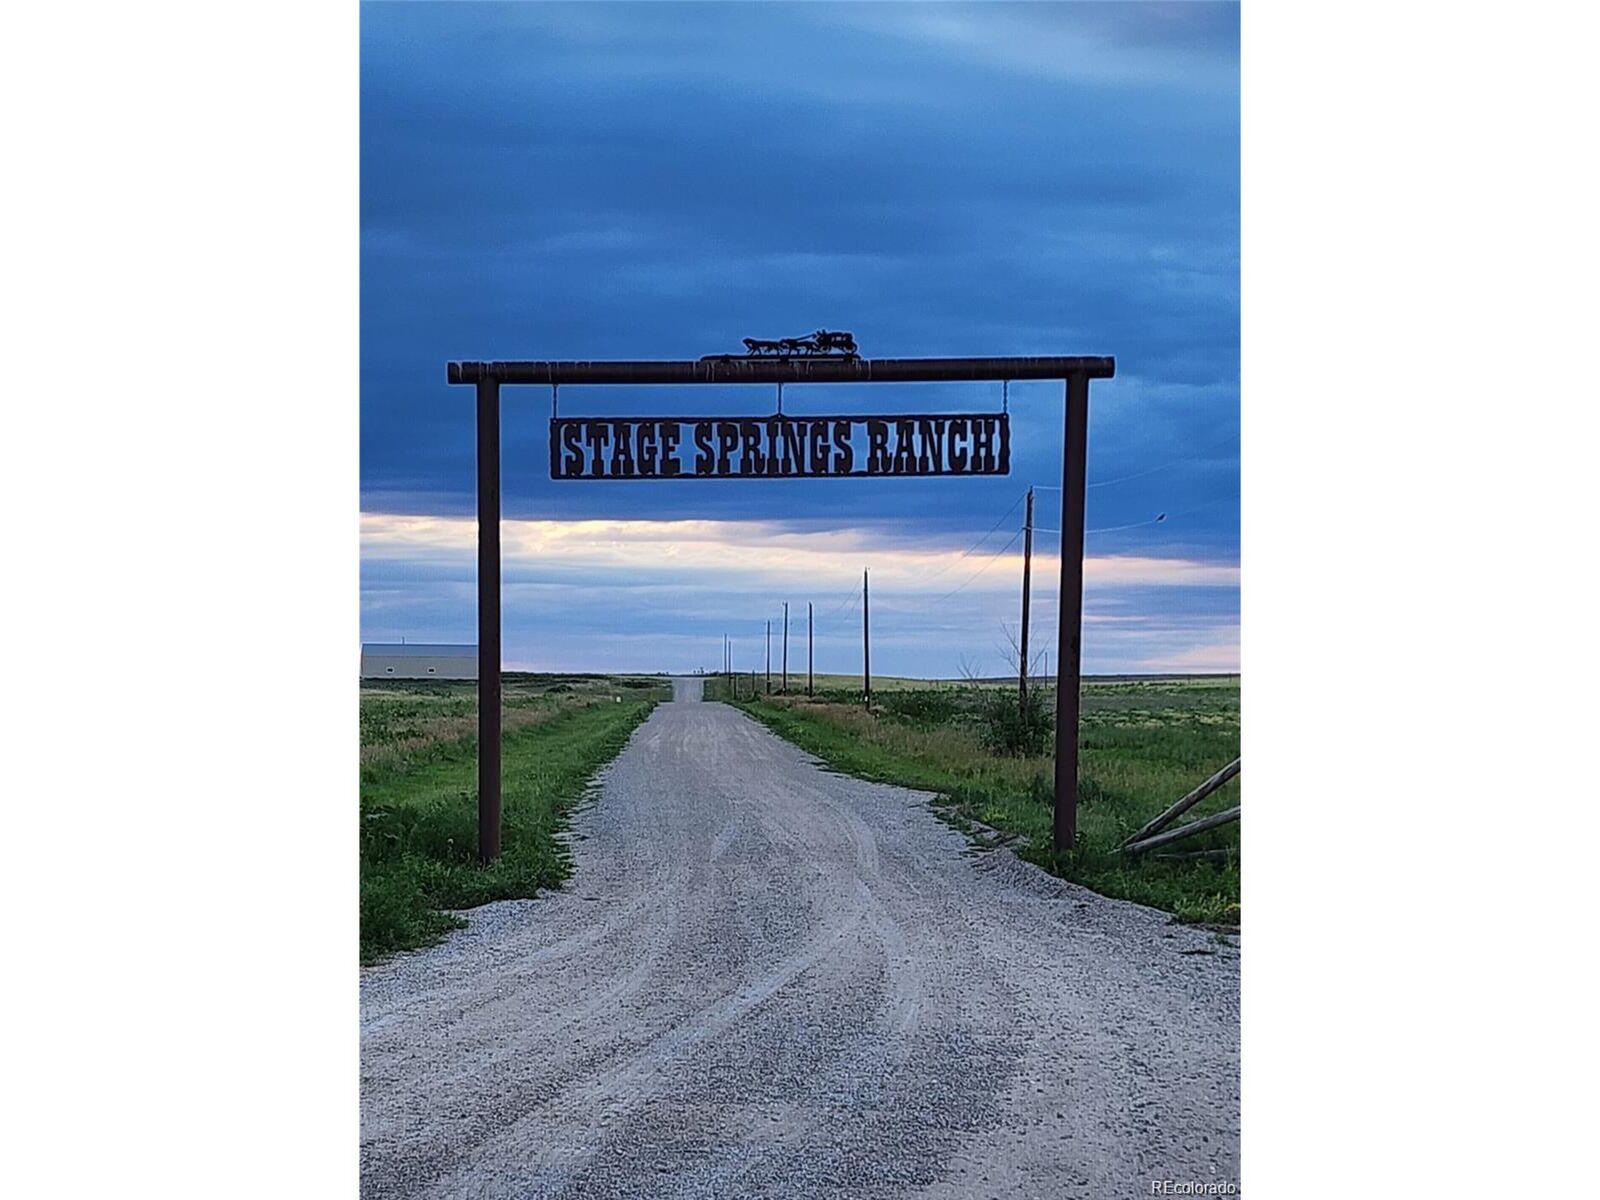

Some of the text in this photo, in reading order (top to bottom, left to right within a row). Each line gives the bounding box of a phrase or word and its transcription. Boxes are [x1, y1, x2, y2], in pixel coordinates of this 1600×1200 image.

[563, 417, 998, 477] STAGE SPRINGS RANCH
